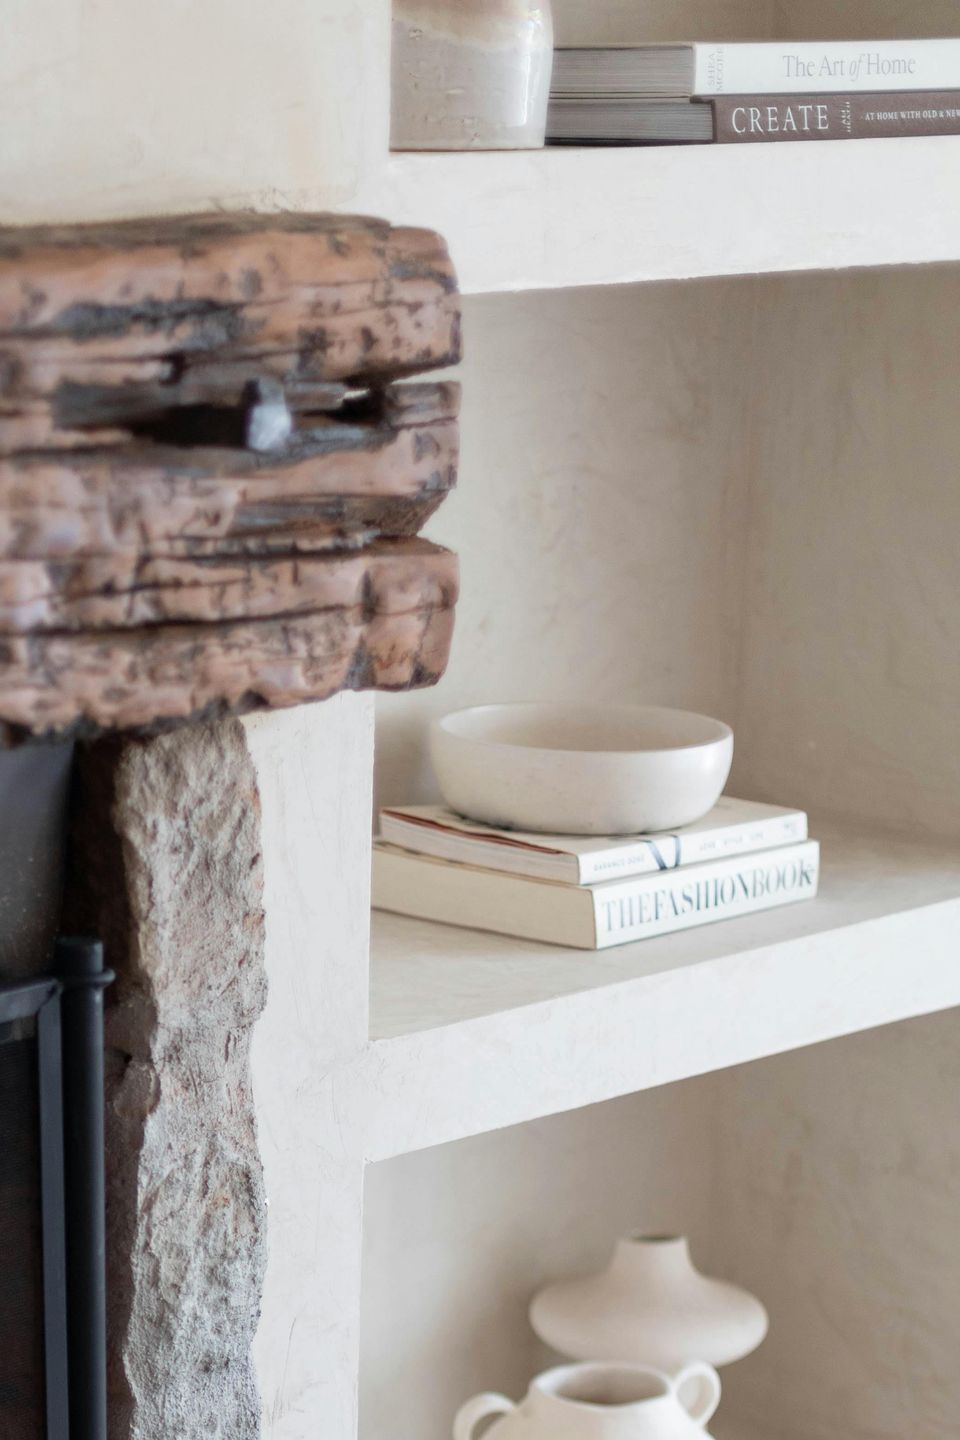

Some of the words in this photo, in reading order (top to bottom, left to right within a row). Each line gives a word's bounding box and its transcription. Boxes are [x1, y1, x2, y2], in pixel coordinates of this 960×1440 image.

[782, 55, 815, 78] The
[818, 55, 846, 77] Art
[848, 53, 865, 82] of
[866, 53, 916, 76] Home
[731, 104, 829, 134] CREATE
[865, 112, 875, 121] AT
[876, 111, 898, 120] HOME
[900, 110, 921, 119] WITH
[922, 109, 938, 118] OLD
